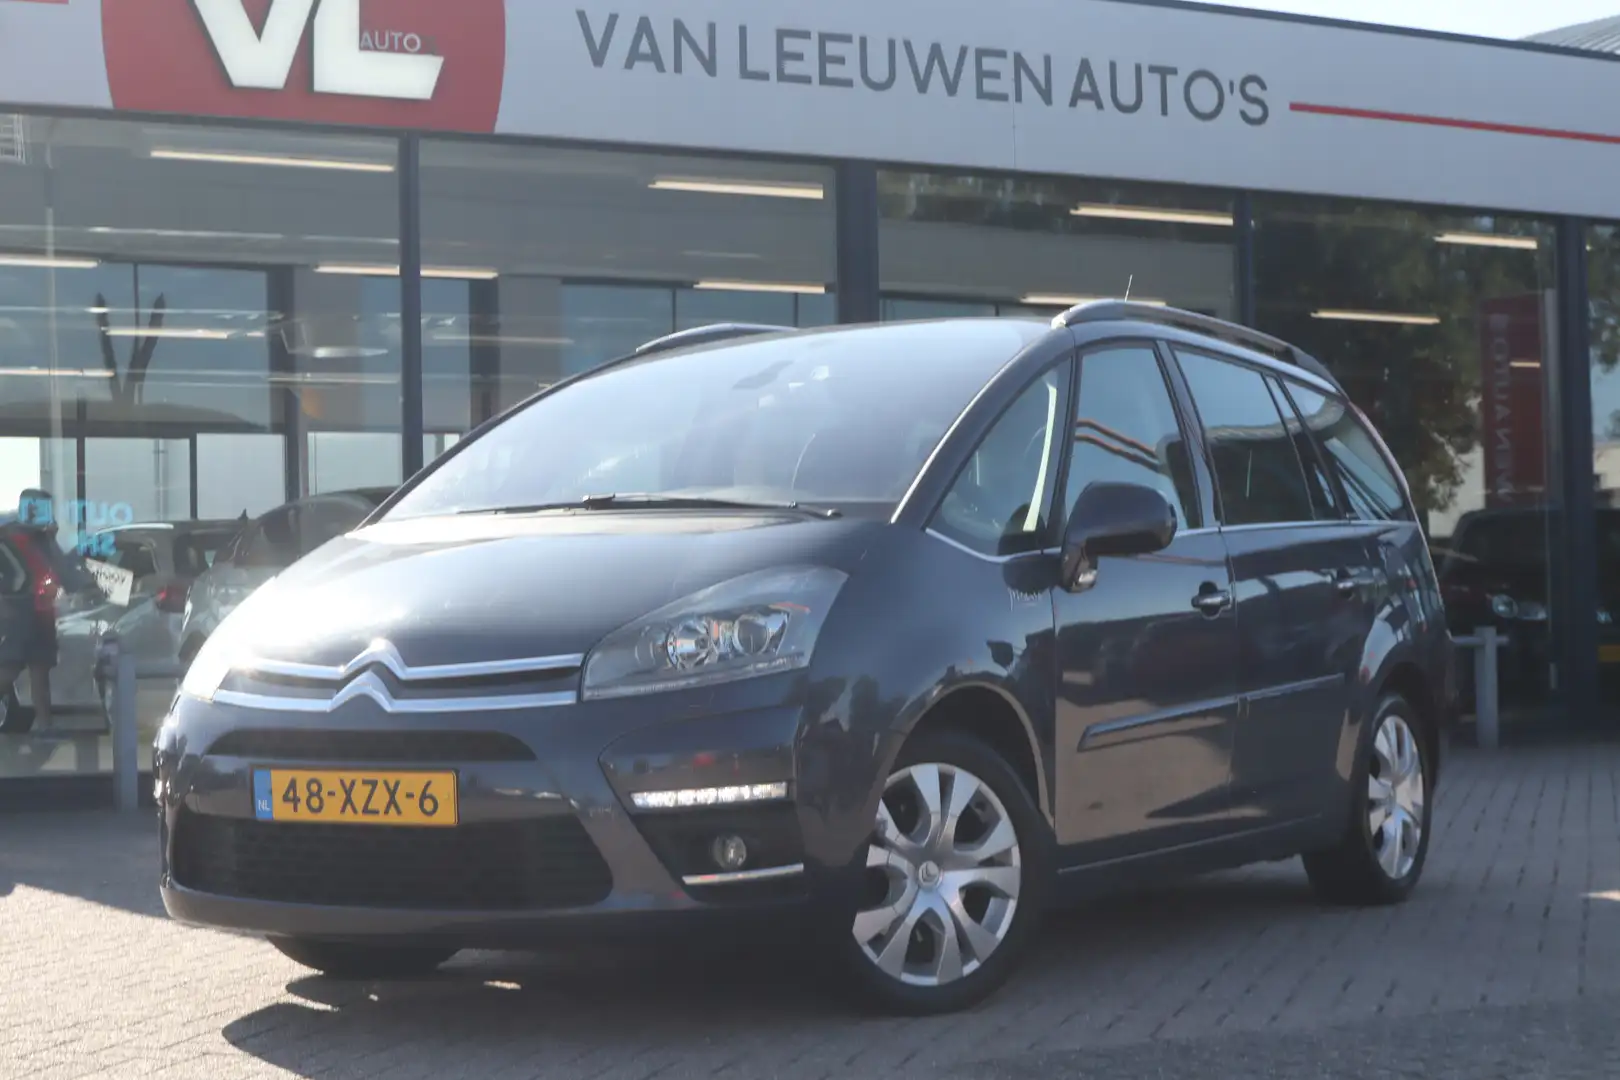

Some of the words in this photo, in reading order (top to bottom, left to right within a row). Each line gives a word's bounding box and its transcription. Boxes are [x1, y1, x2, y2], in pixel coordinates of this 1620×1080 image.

[360, 29, 421, 52] AUTO
[576, 10, 717, 77] VAN
[738, 25, 1052, 106] LEEUWEN
[1068, 56, 1269, 126] AUTO'S
[258, 799, 271, 811] NL
[282, 777, 439, 817] 48-XZX-6
